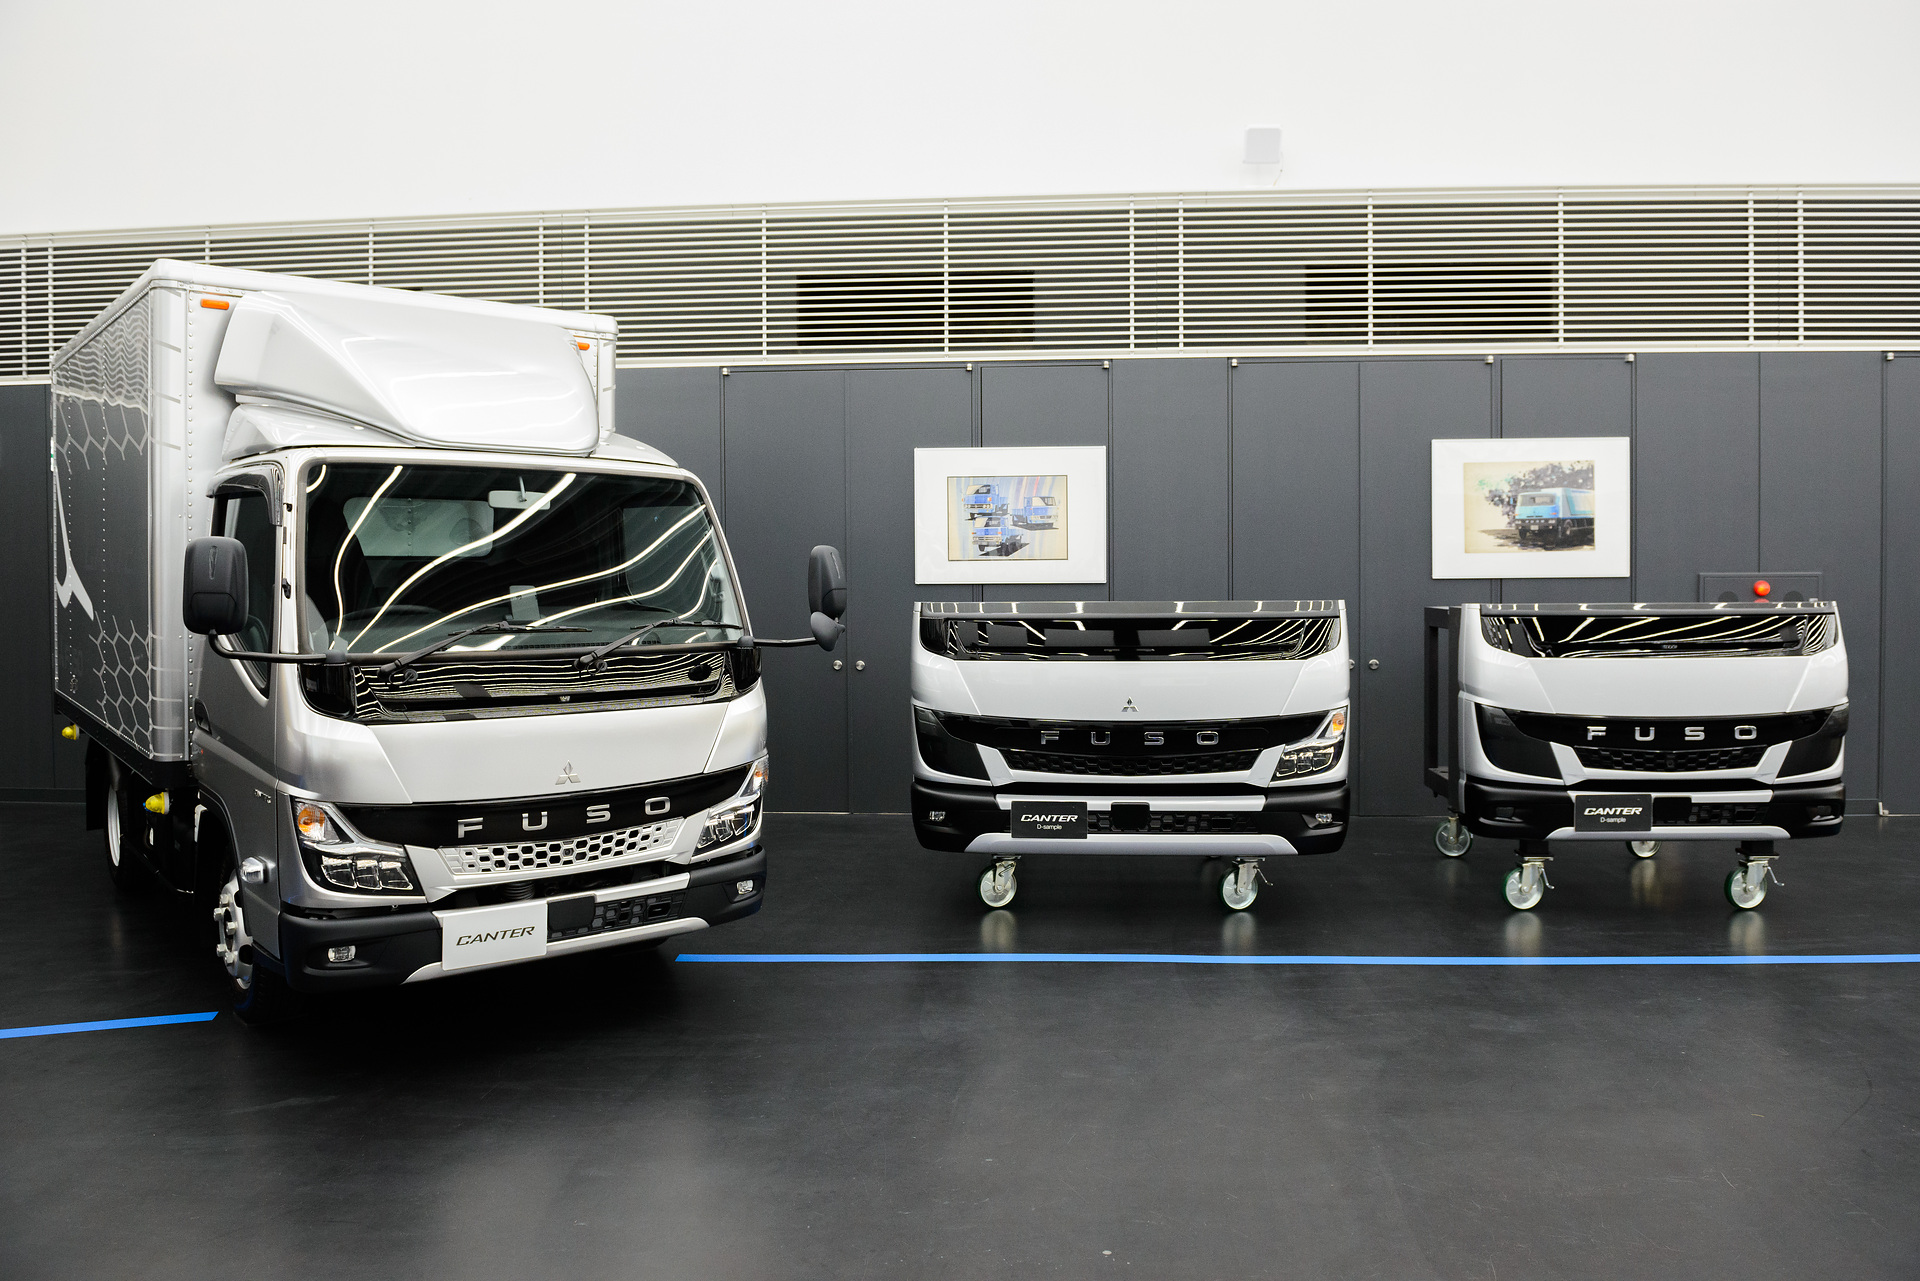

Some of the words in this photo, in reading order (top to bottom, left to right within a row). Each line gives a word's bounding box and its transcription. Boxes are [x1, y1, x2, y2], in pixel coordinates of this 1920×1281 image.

[1040, 730, 1220, 746] FUSO
[1586, 725, 1758, 741] FUSO
[457, 796, 671, 839] FUSO
[1583, 807, 1643, 816] CANTER
[1020, 814, 1079, 822] CANTER
[1600, 816, 1627, 824] D-sample
[1036, 823, 1063, 831] D-sample
[456, 926, 536, 947] CANTER
